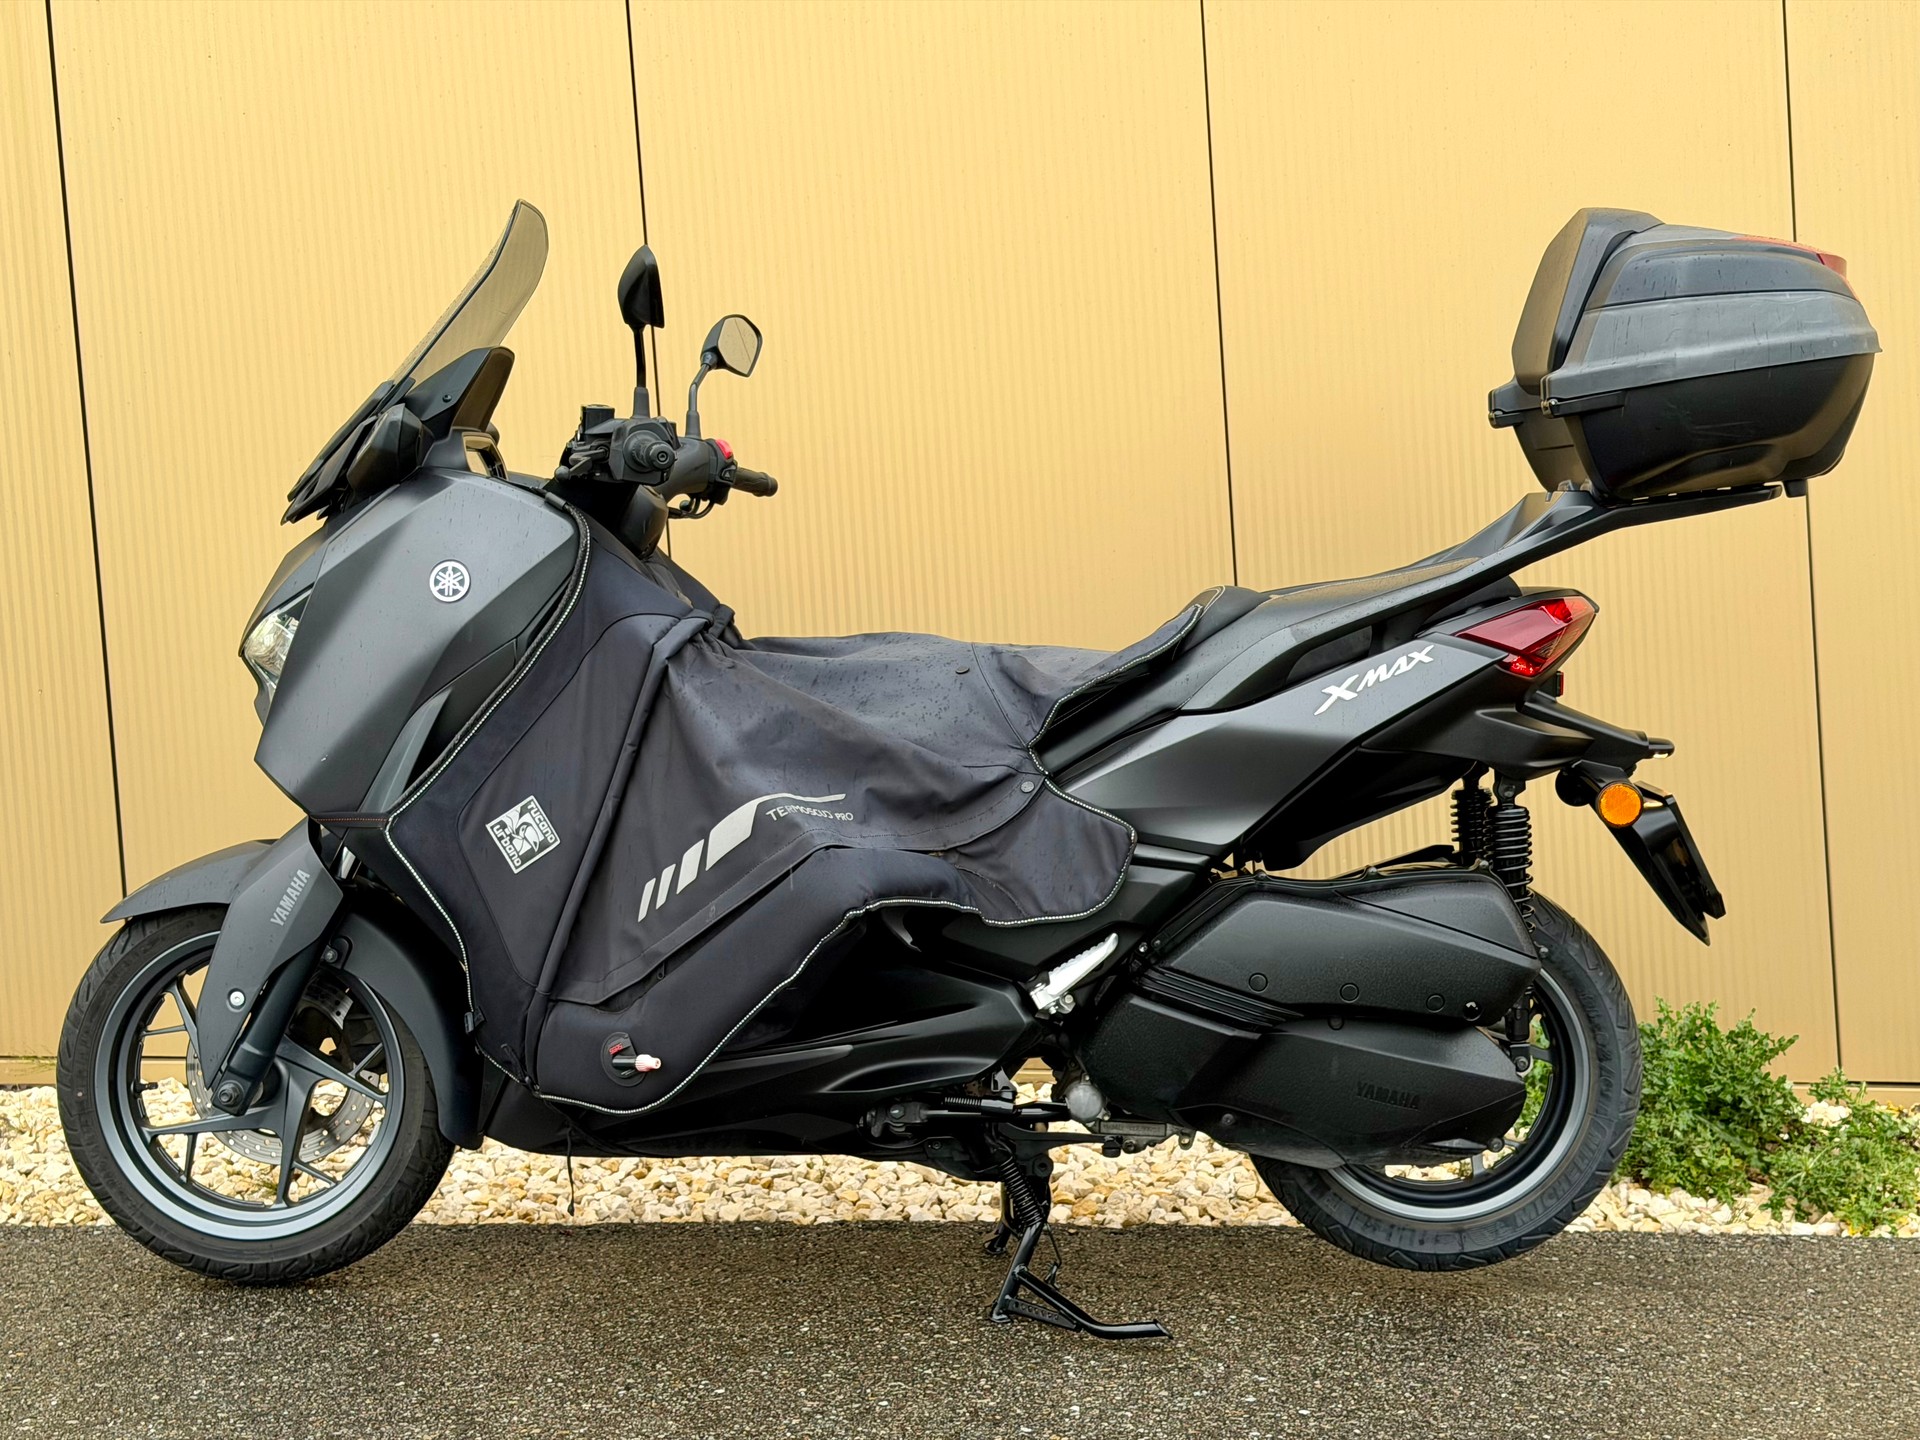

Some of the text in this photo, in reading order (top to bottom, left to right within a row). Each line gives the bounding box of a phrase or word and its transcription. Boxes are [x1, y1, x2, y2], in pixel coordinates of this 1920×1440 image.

[1313, 644, 1435, 716] XMAX
[834, 812, 854, 821] PRO
[270, 869, 311, 926] YAMAHA
[1356, 1080, 1419, 1110] YAMAHA
[1513, 1128, 1603, 1227] MICHELIN
